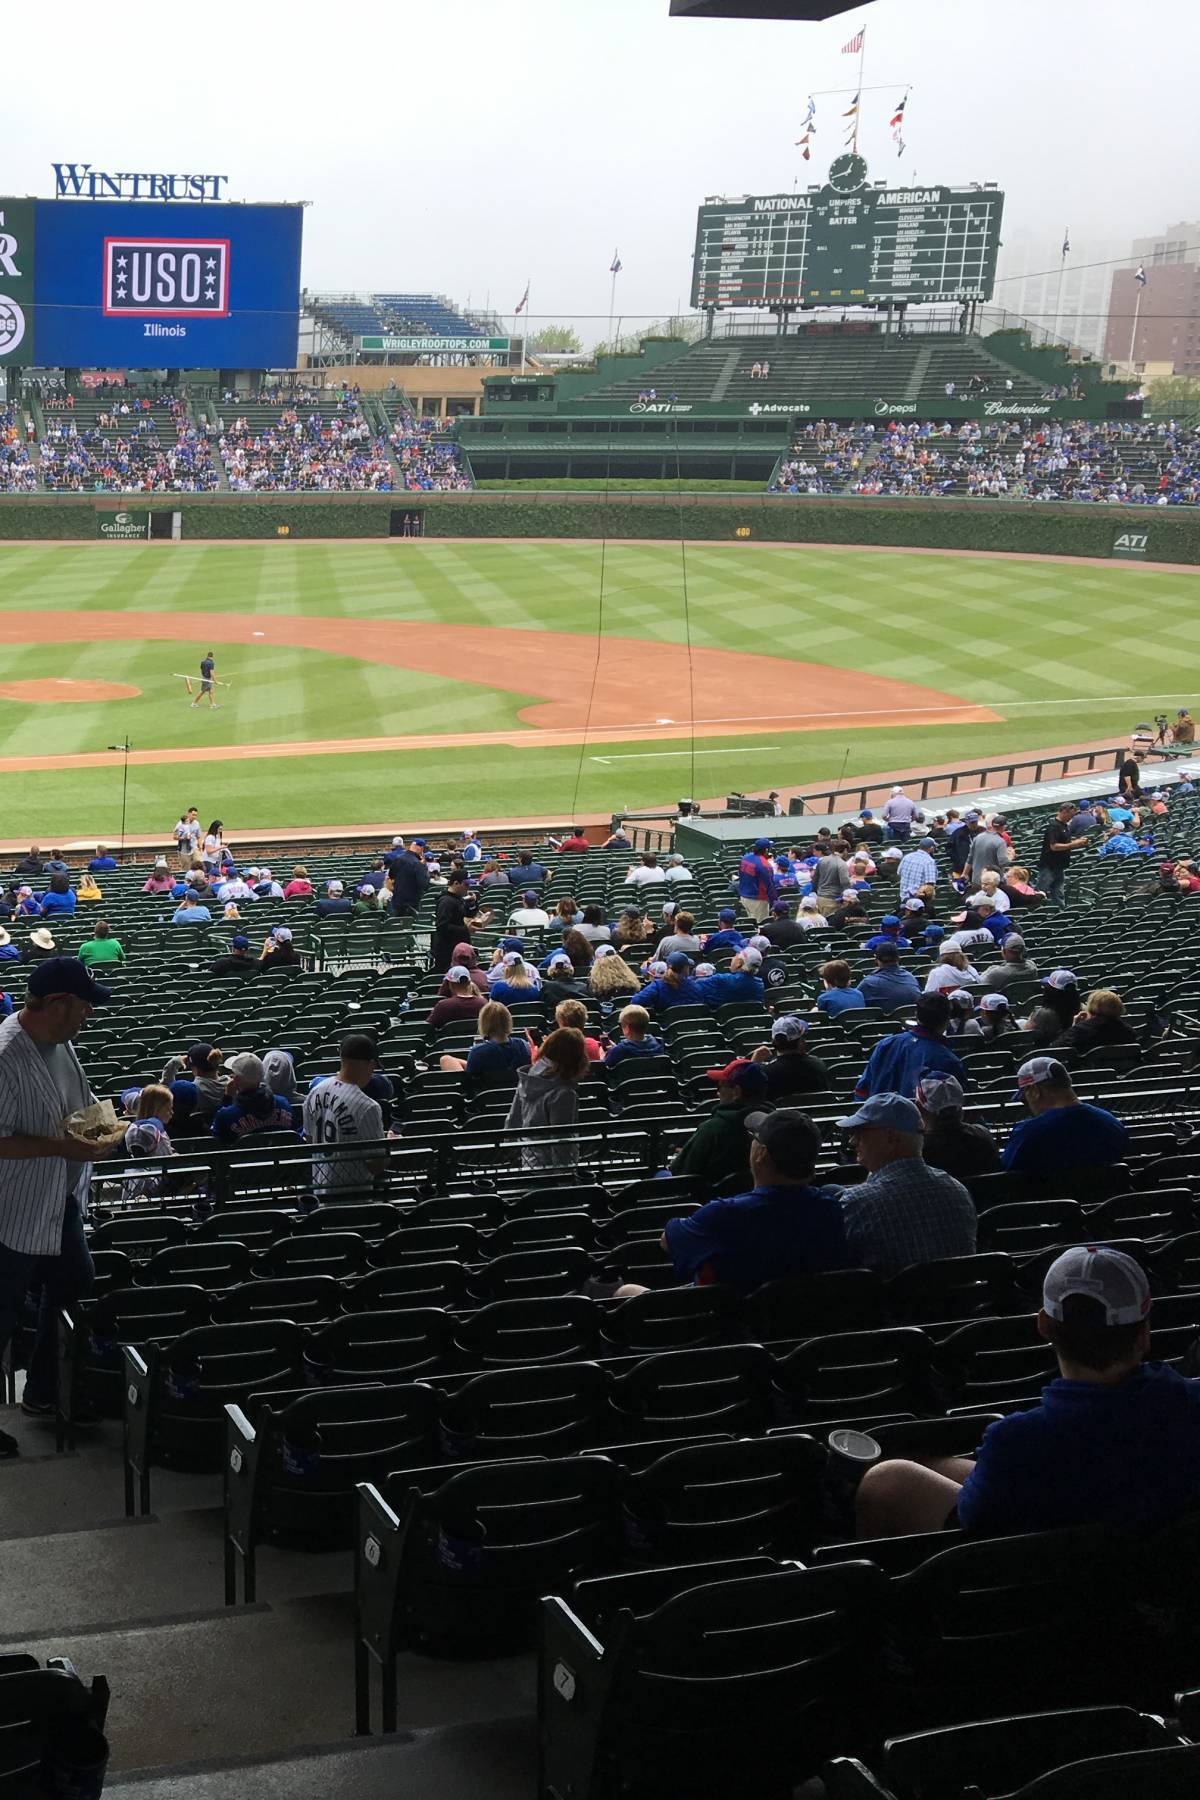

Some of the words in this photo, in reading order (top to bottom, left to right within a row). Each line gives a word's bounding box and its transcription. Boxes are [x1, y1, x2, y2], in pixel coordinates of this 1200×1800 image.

[51, 163, 228, 201] WINTRUST
[754, 197, 814, 211] NATIONAL
[829, 198, 862, 206] UMPIRES
[876, 190, 940, 205] AMERICAN
[829, 217, 857, 225] BATTER
[132, 252, 201, 303] USO
[143, 323, 187, 337] Illinois
[644, 403, 671, 413] ATI
[763, 403, 810, 413] Advocate
[889, 403, 917, 414] pepsi
[983, 401, 1052, 416] Budweiser
[100, 523, 146, 534] Gallagher
[1114, 534, 1148, 547] ATI
